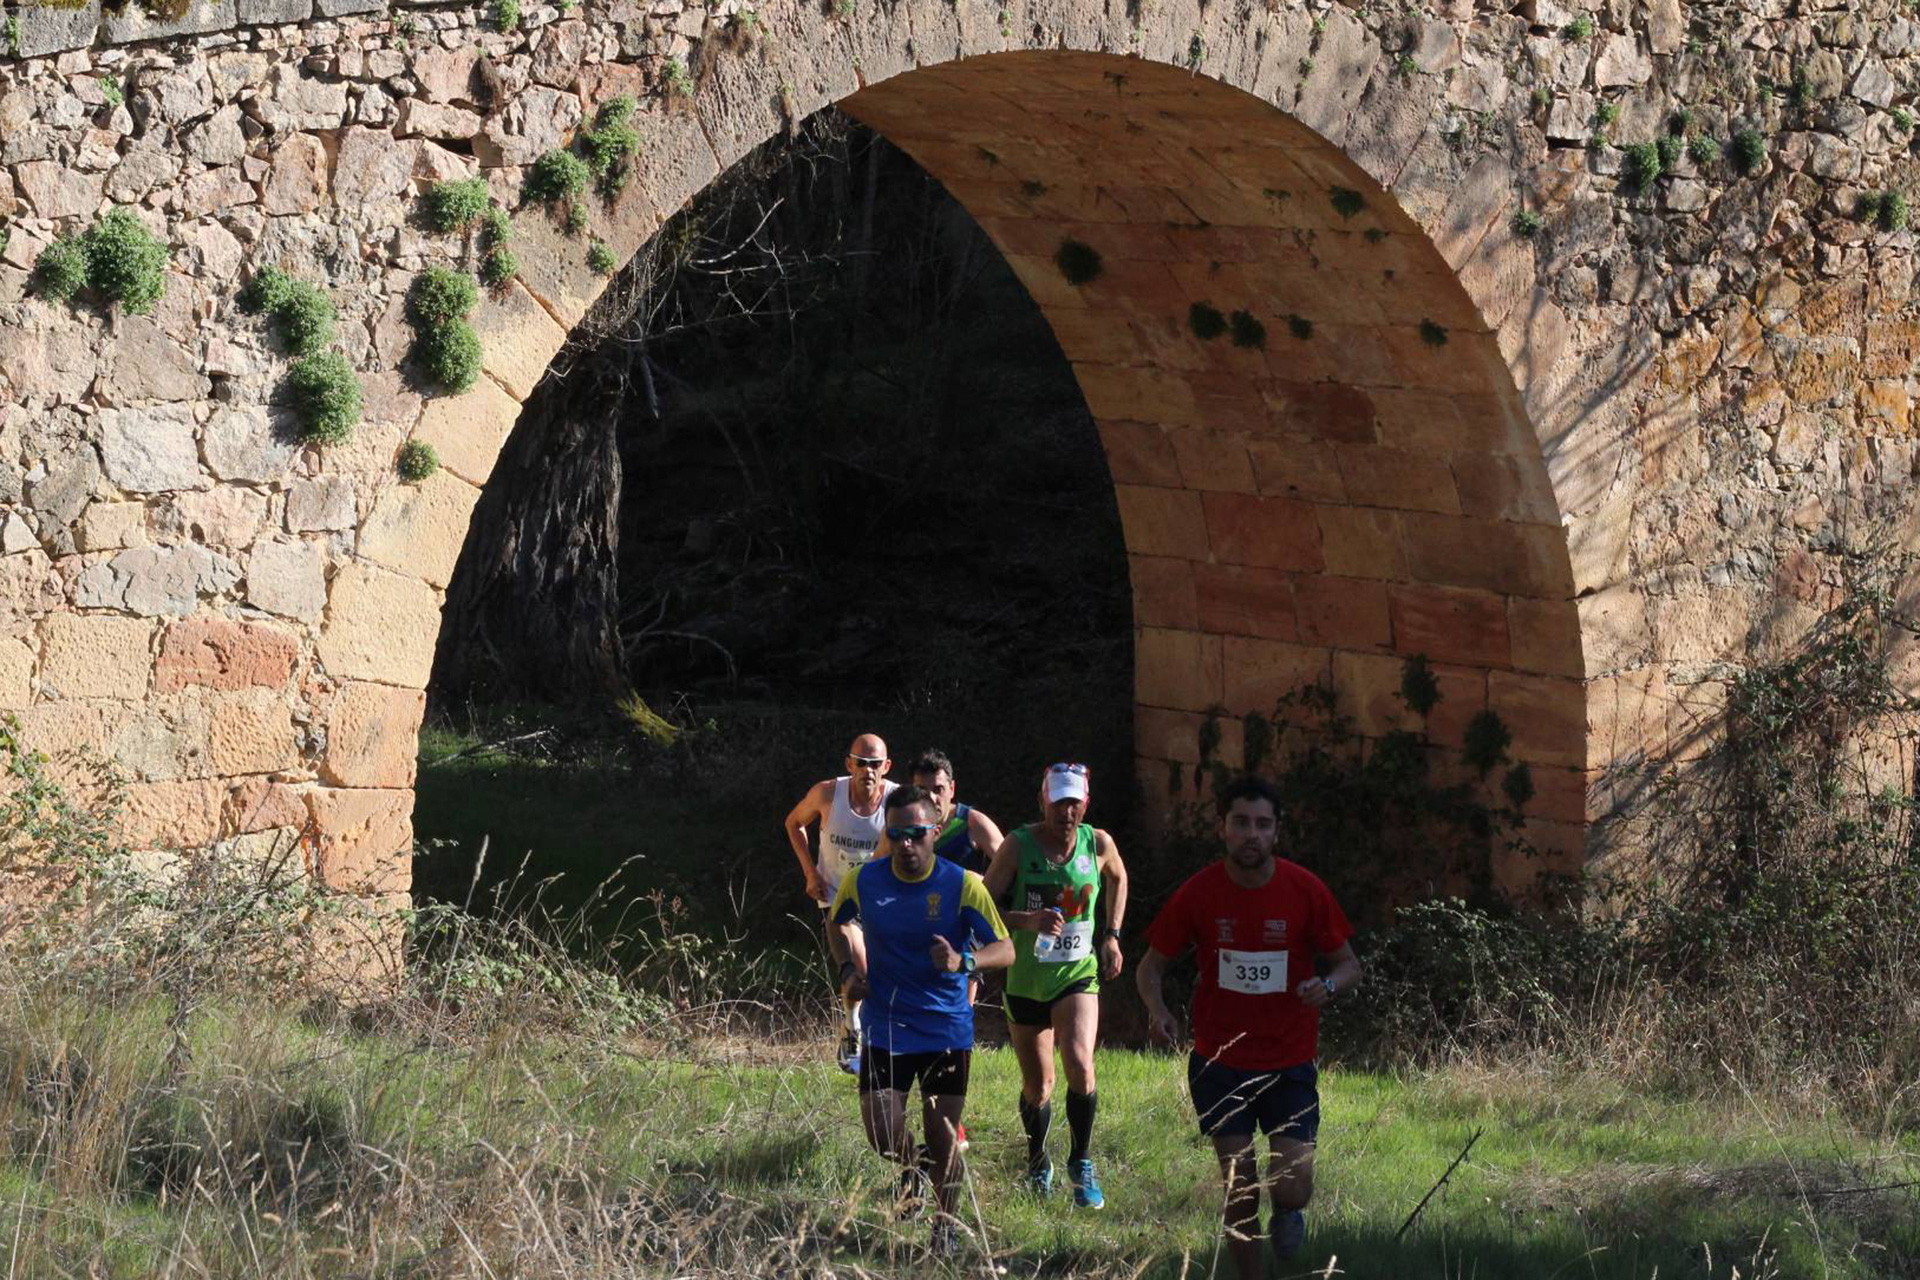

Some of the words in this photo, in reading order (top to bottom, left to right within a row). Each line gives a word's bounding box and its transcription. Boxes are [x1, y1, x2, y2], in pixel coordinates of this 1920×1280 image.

[830, 834, 872, 850] CANGURO
[1053, 935, 1081, 950] 362
[1235, 965, 1271, 981] 339
